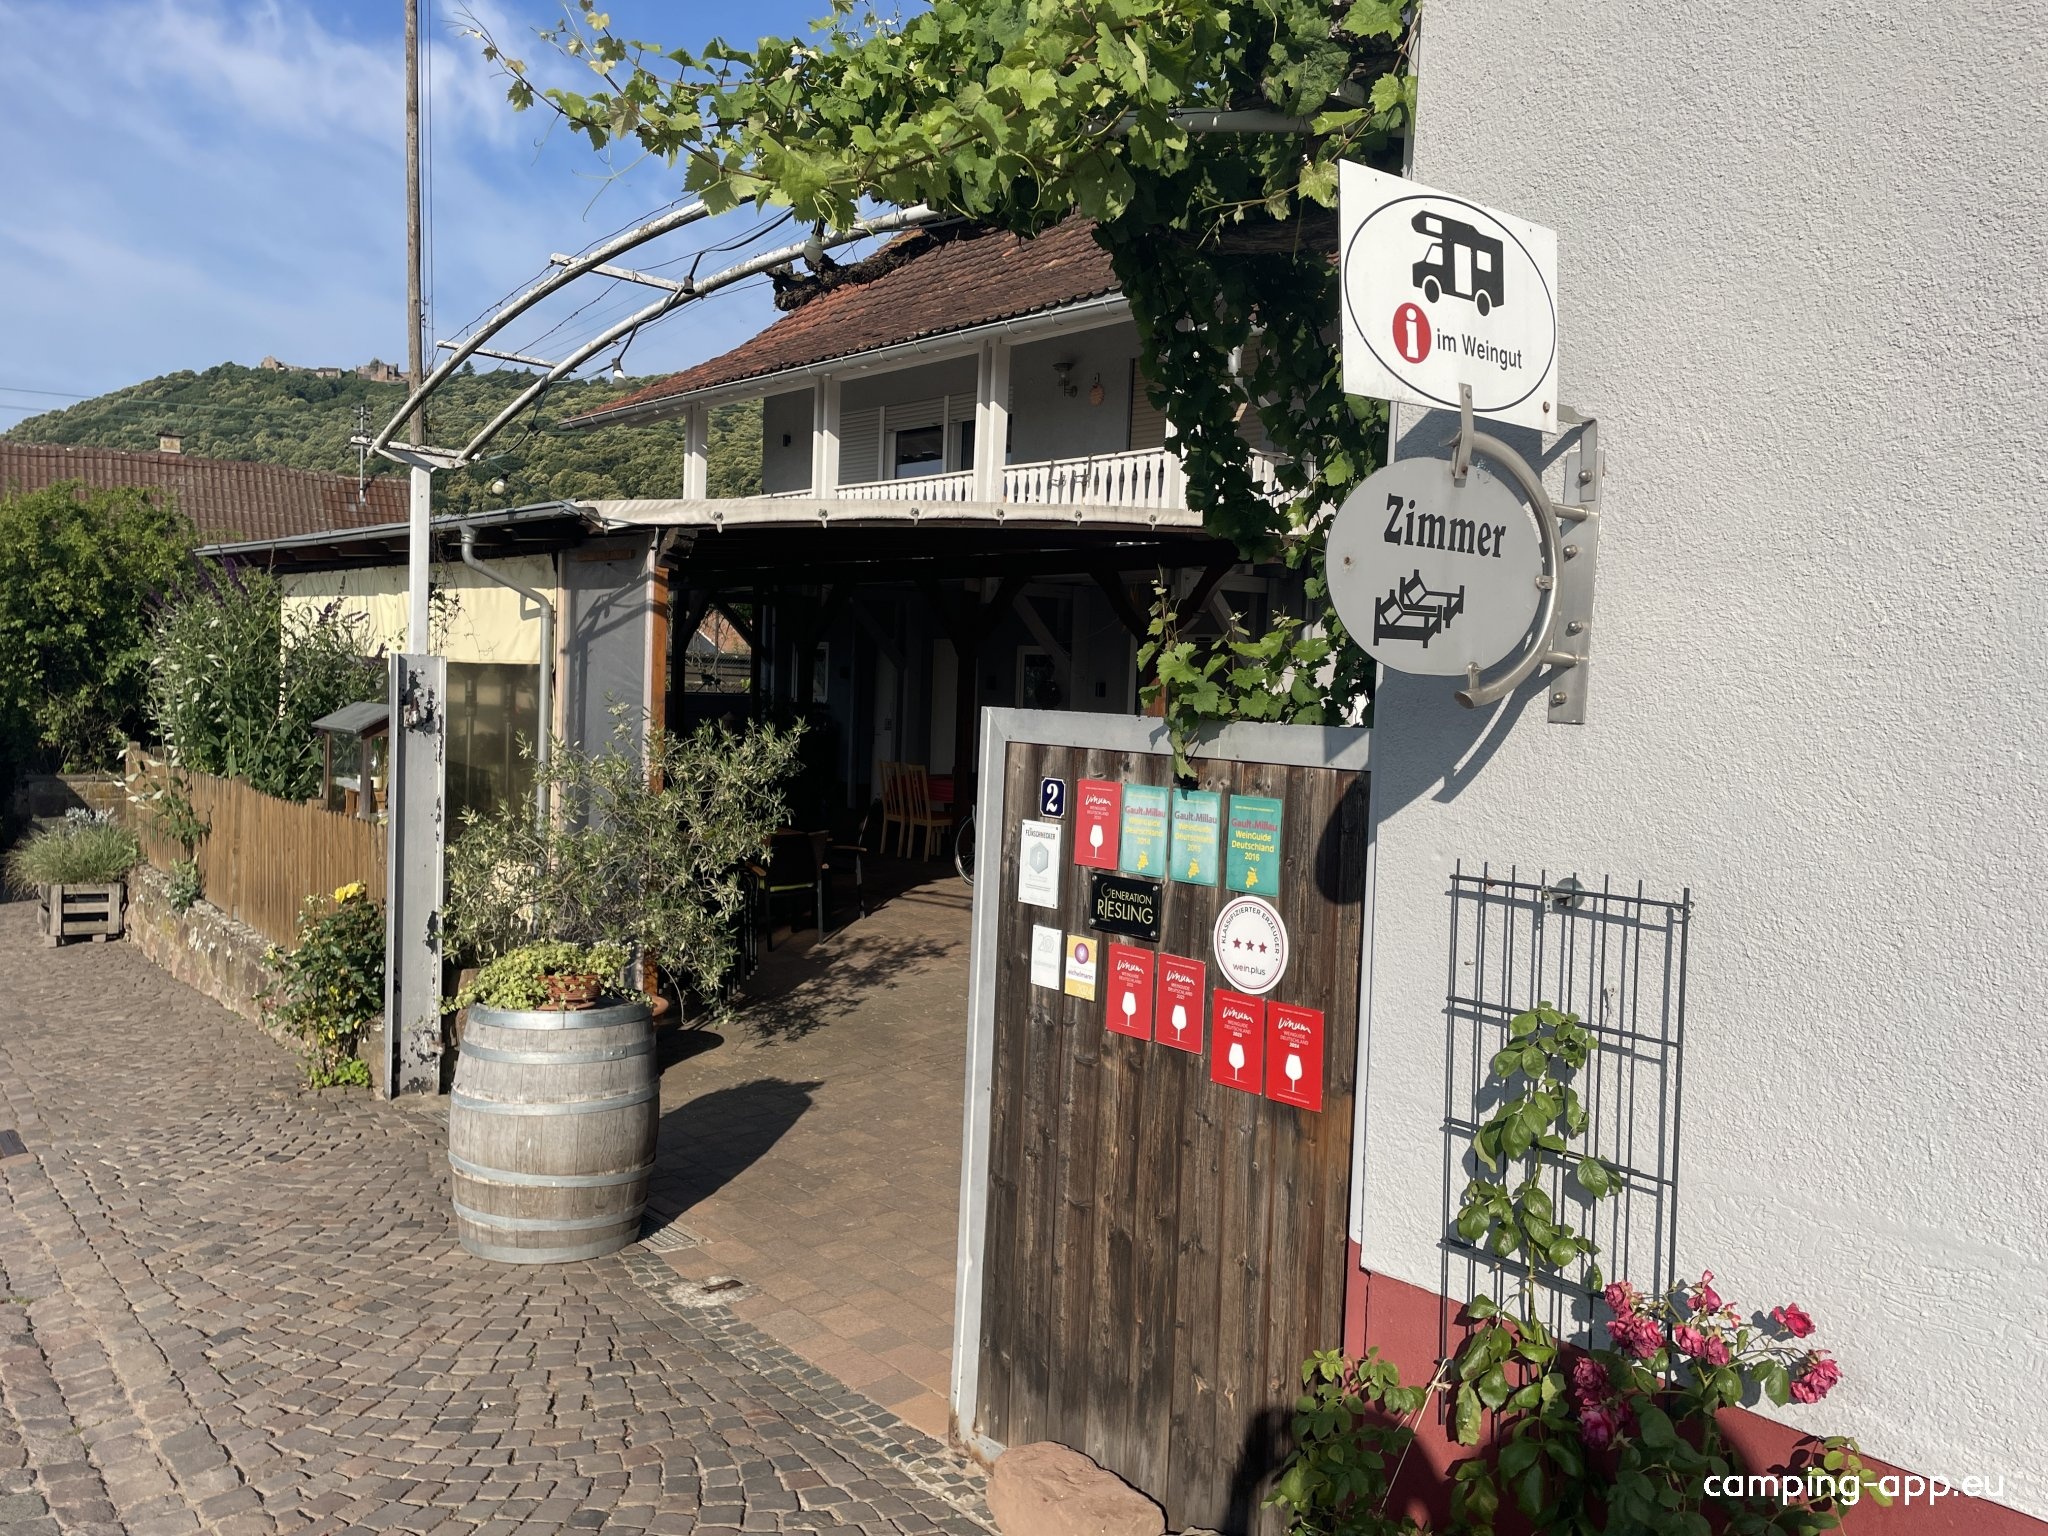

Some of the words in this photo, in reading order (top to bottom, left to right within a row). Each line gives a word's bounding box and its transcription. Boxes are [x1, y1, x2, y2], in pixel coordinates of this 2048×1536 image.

[1437, 328, 1457, 352] im
[1462, 334, 1522, 370] Weingut
[1384, 493, 1507, 558] Zimmer
[1046, 783, 1058, 813] 2
[1231, 841, 1275, 853] Deutschland
[1235, 830, 1272, 842] WeinGuide
[1244, 852, 1260, 862] 2016
[1101, 882, 1152, 906] GENERATION
[1097, 898, 1154, 925] RIESLING
[1221, 906, 1261, 944] KLASSIFIZIERTER
[1261, 912, 1280, 954] ERZEUGER
[1068, 969, 1094, 980] eichelmann
[1233, 963, 1266, 976] wein.plus
